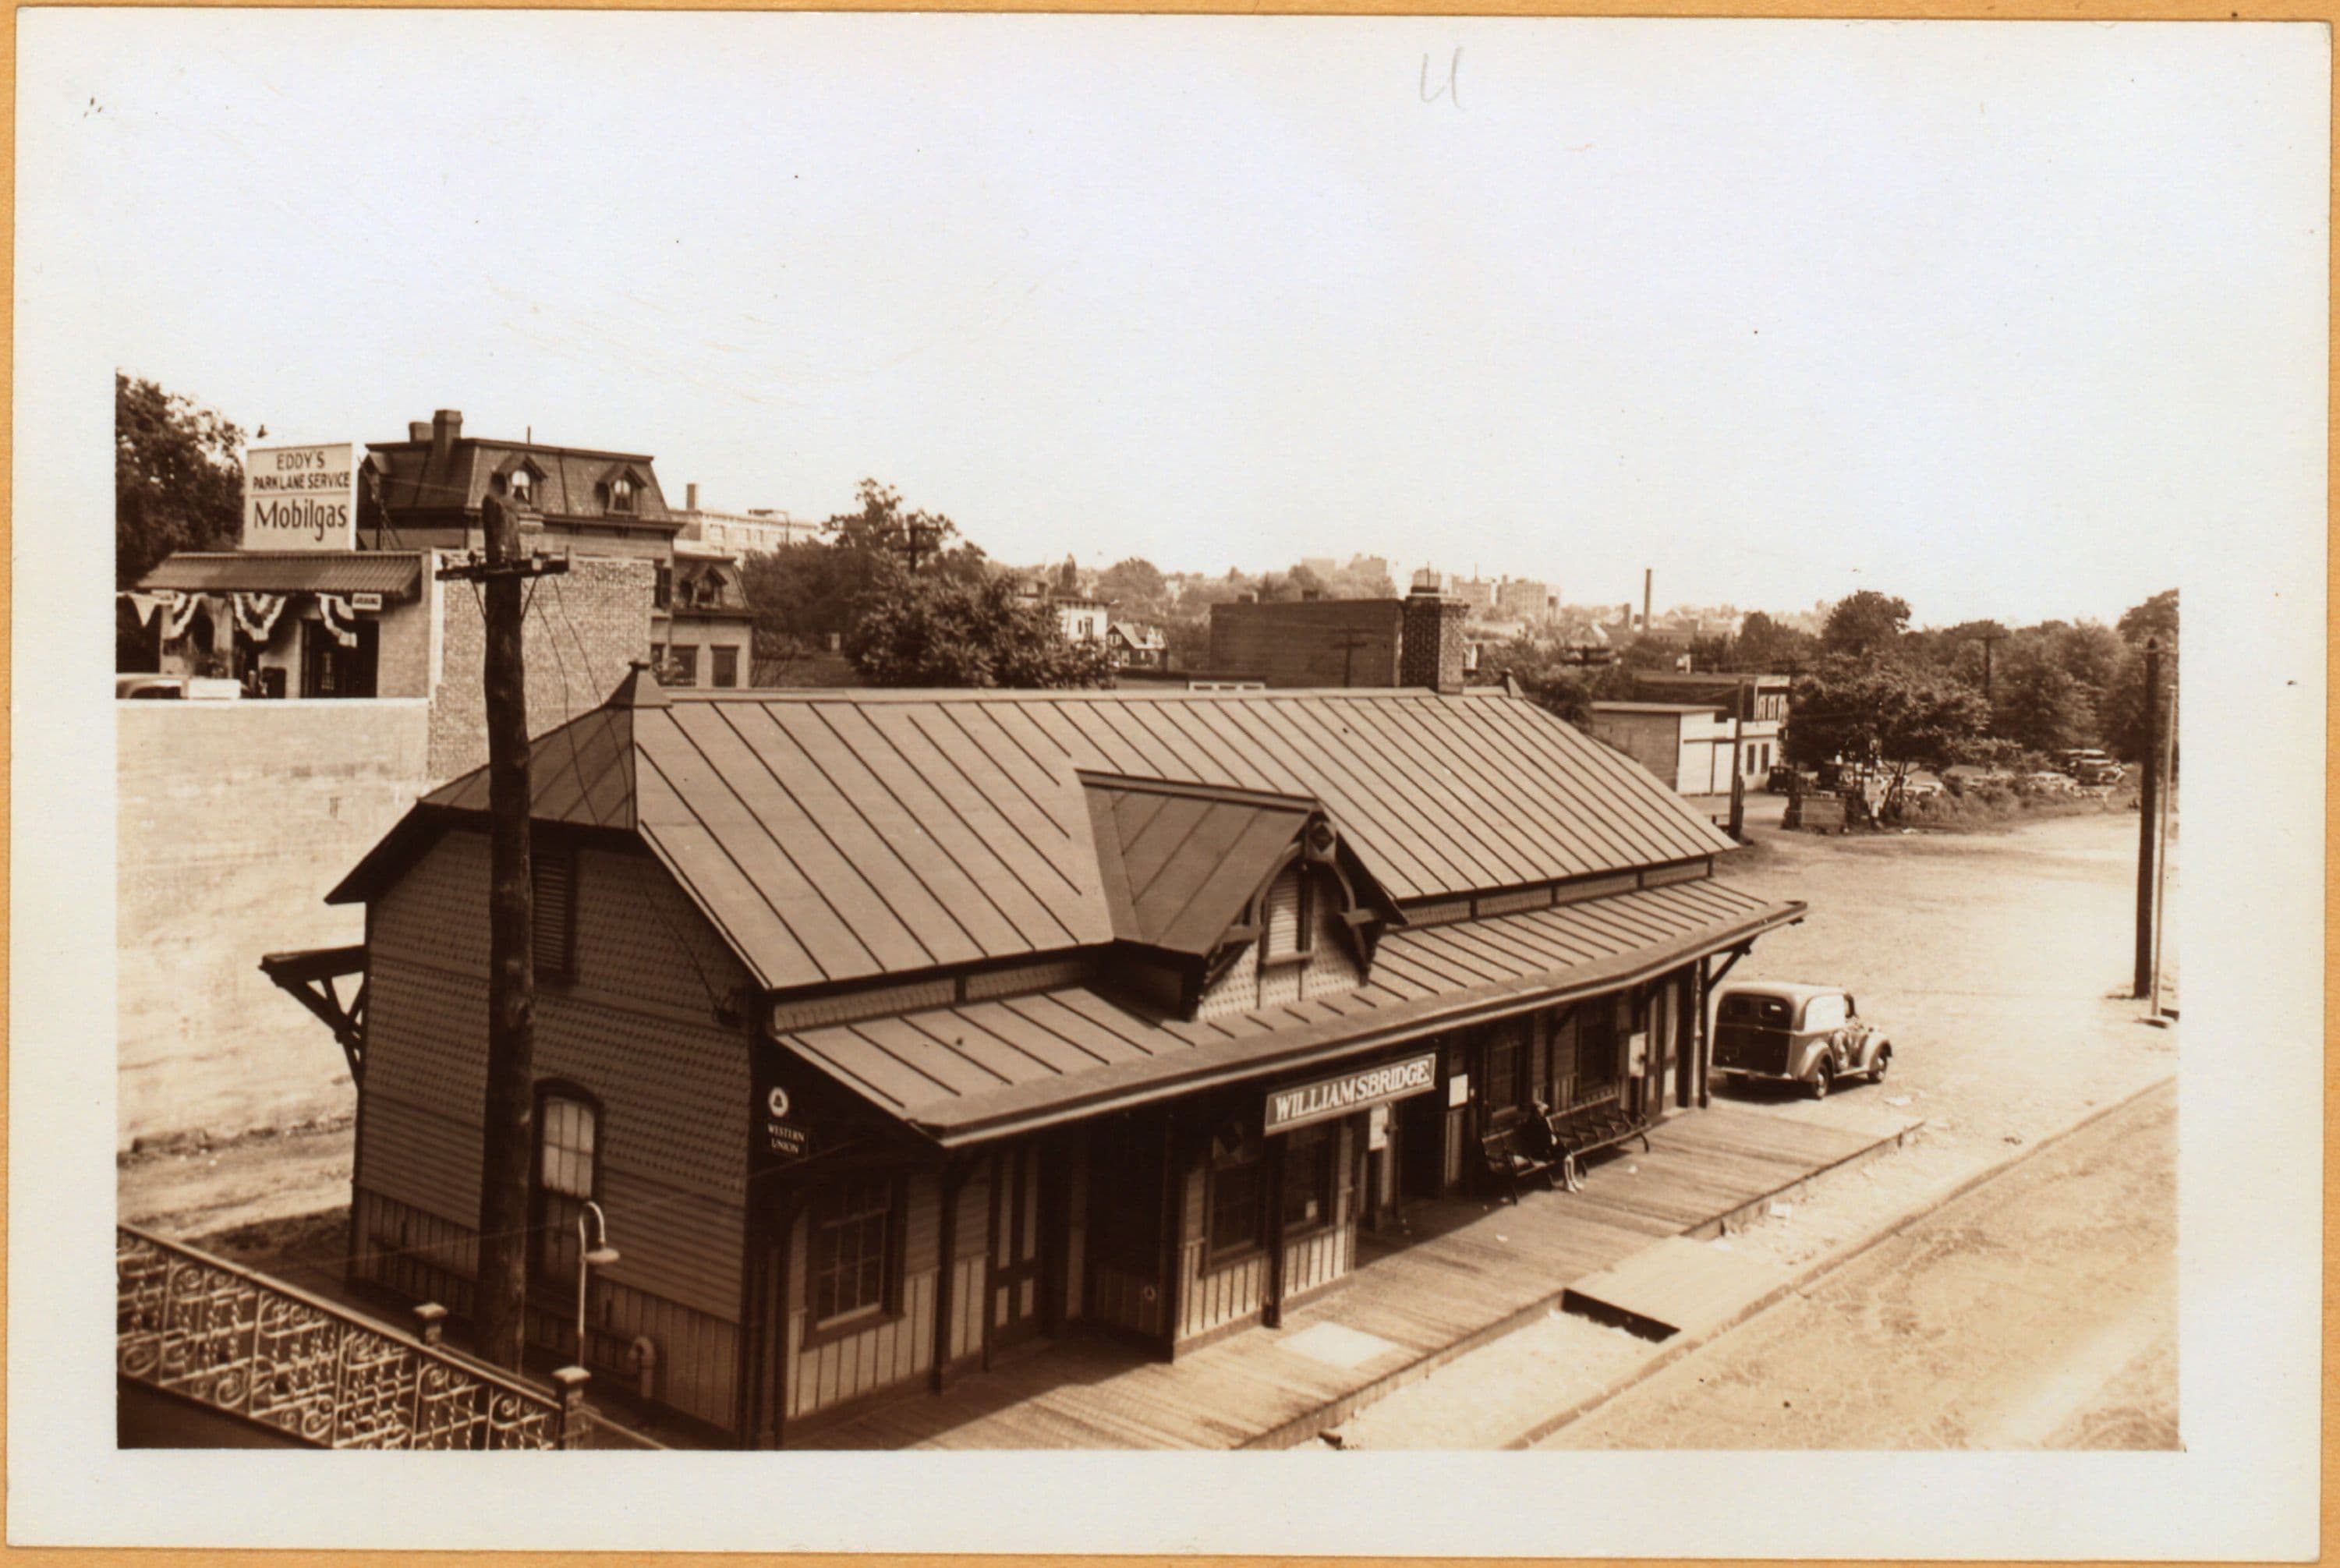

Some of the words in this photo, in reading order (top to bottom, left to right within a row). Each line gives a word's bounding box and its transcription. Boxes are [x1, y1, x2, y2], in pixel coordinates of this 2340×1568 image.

[277, 451, 325, 470] EDDY'S
[307, 471, 350, 489] SERVICE
[254, 498, 348, 542] Mobilgas
[1276, 1060, 1430, 1123] WILLIAMSBRIDGE
[767, 1123, 805, 1141] WESTERN
[771, 1138, 798, 1154] UNION
